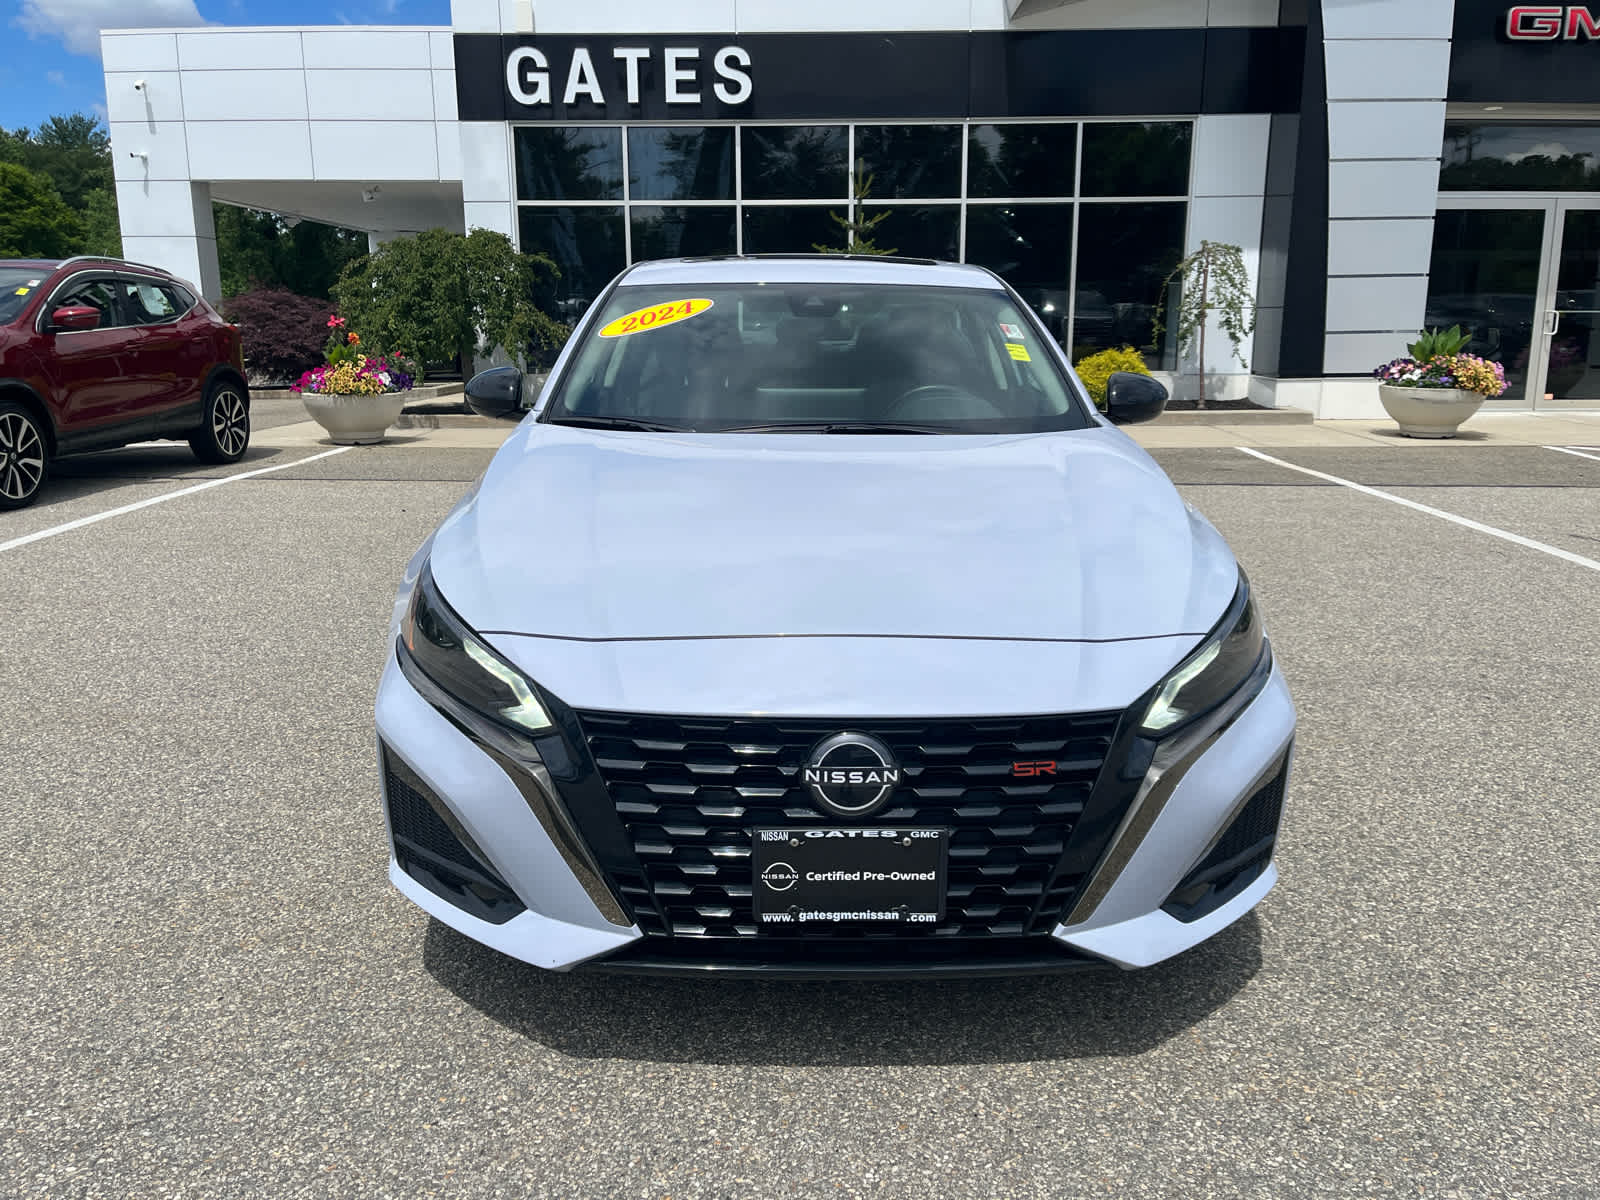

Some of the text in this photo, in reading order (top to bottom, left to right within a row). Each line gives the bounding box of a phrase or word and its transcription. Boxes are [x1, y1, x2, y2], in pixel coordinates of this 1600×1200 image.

[506, 46, 752, 105] GATES
[621, 301, 694, 333] 2024
[805, 769, 898, 784] NISSAN
[1013, 760, 1057, 777] SR
[761, 830, 940, 841] NISSAN GATES GMC
[805, 871, 936, 881] Certified Pre-Owned
